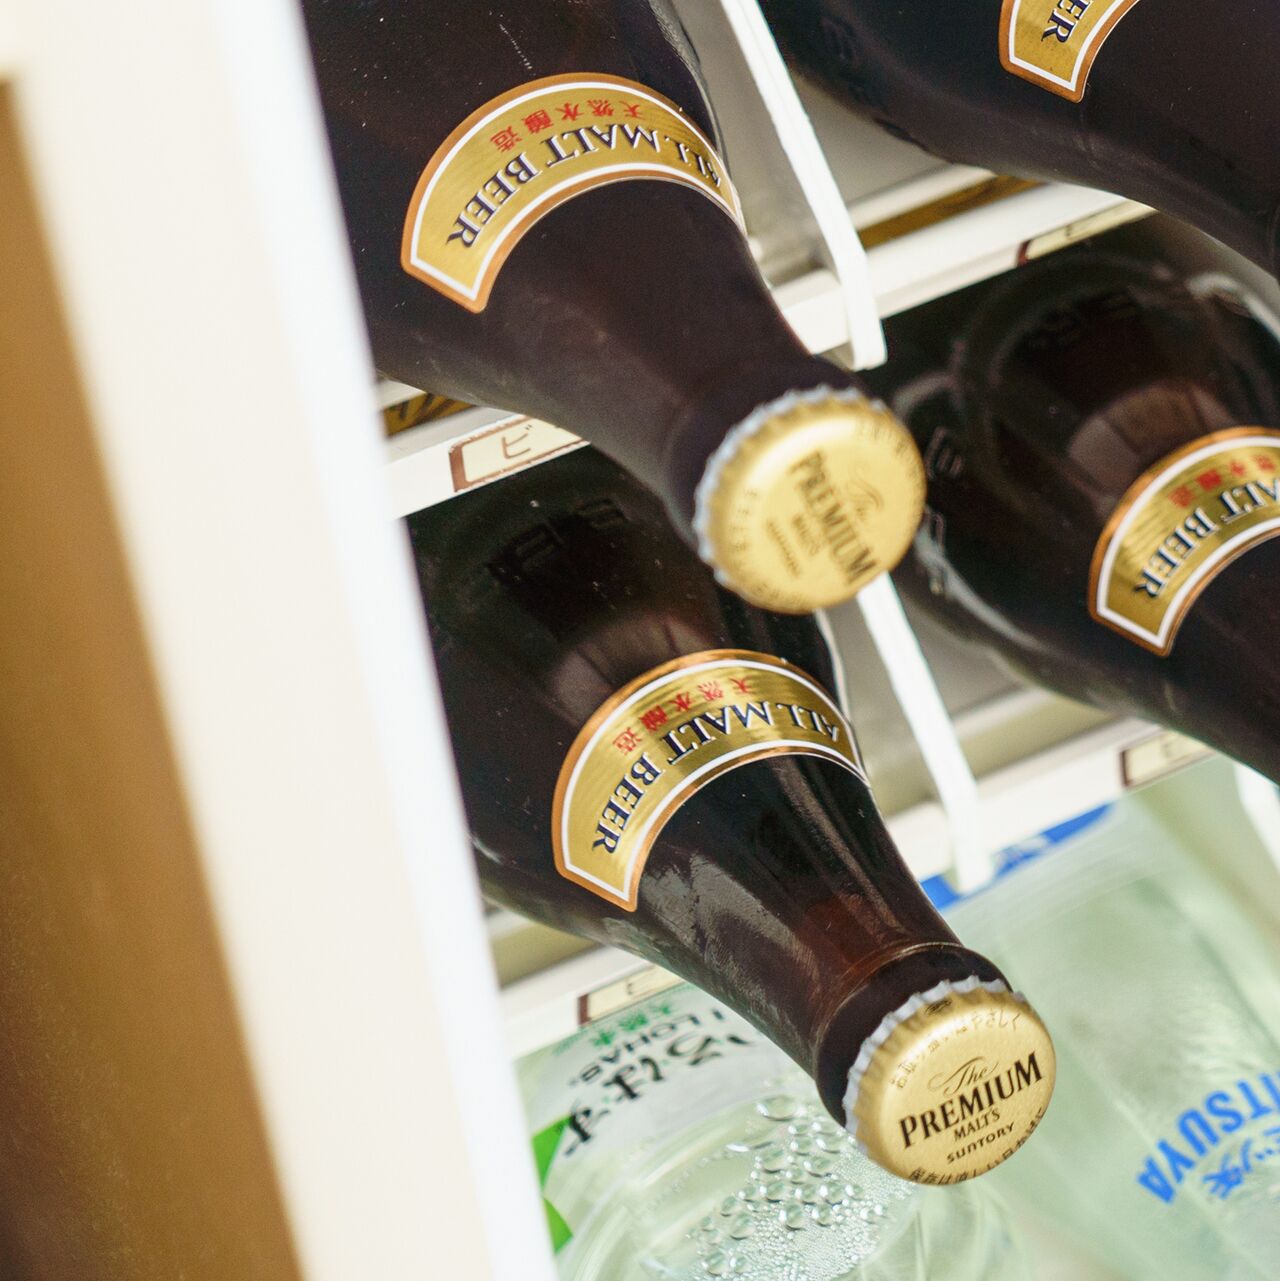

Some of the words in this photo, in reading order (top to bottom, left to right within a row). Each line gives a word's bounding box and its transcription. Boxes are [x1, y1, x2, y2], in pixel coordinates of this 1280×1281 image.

[489, 98, 644, 152] 天然水醸造
[539, 123, 661, 170] MALT
[446, 150, 539, 251] BEER
[787, 450, 881, 585] PREMIUM
[1132, 507, 1218, 600] BEER
[611, 675, 752, 756] 天然水醸造
[658, 700, 774, 765] MALT
[776, 701, 839, 742] ALL
[591, 751, 664, 856] BEER
[898, 1050, 1044, 1150] PREMIUM
[926, 1055, 1001, 1097] The
[946, 1121, 1016, 1165] SUNTORY
[952, 1107, 1003, 1143] MALT'S
